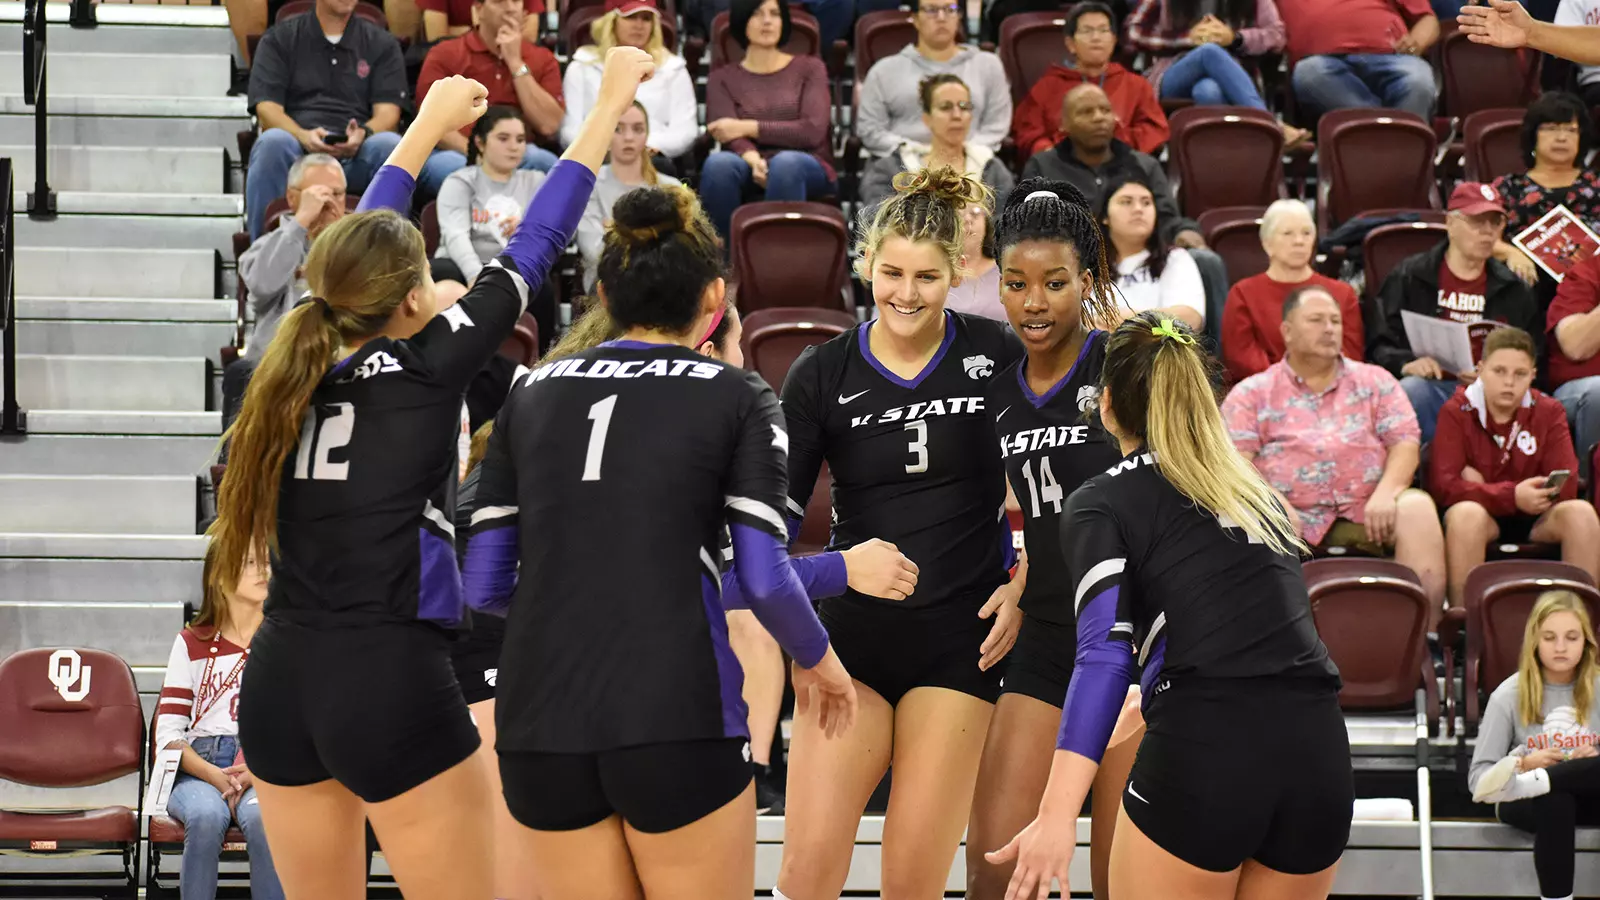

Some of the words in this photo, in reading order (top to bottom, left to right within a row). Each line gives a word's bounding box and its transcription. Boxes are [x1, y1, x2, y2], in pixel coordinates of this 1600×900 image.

[525, 359, 724, 388] WILDCATS
[294, 402, 355, 480] 12
[581, 394, 618, 481] 1
[904, 419, 928, 474] 3
[1517, 430, 1537, 456] OU
[1021, 456, 1063, 518] 14
[48, 650, 91, 701] OU
[1528, 734, 1549, 751] All
